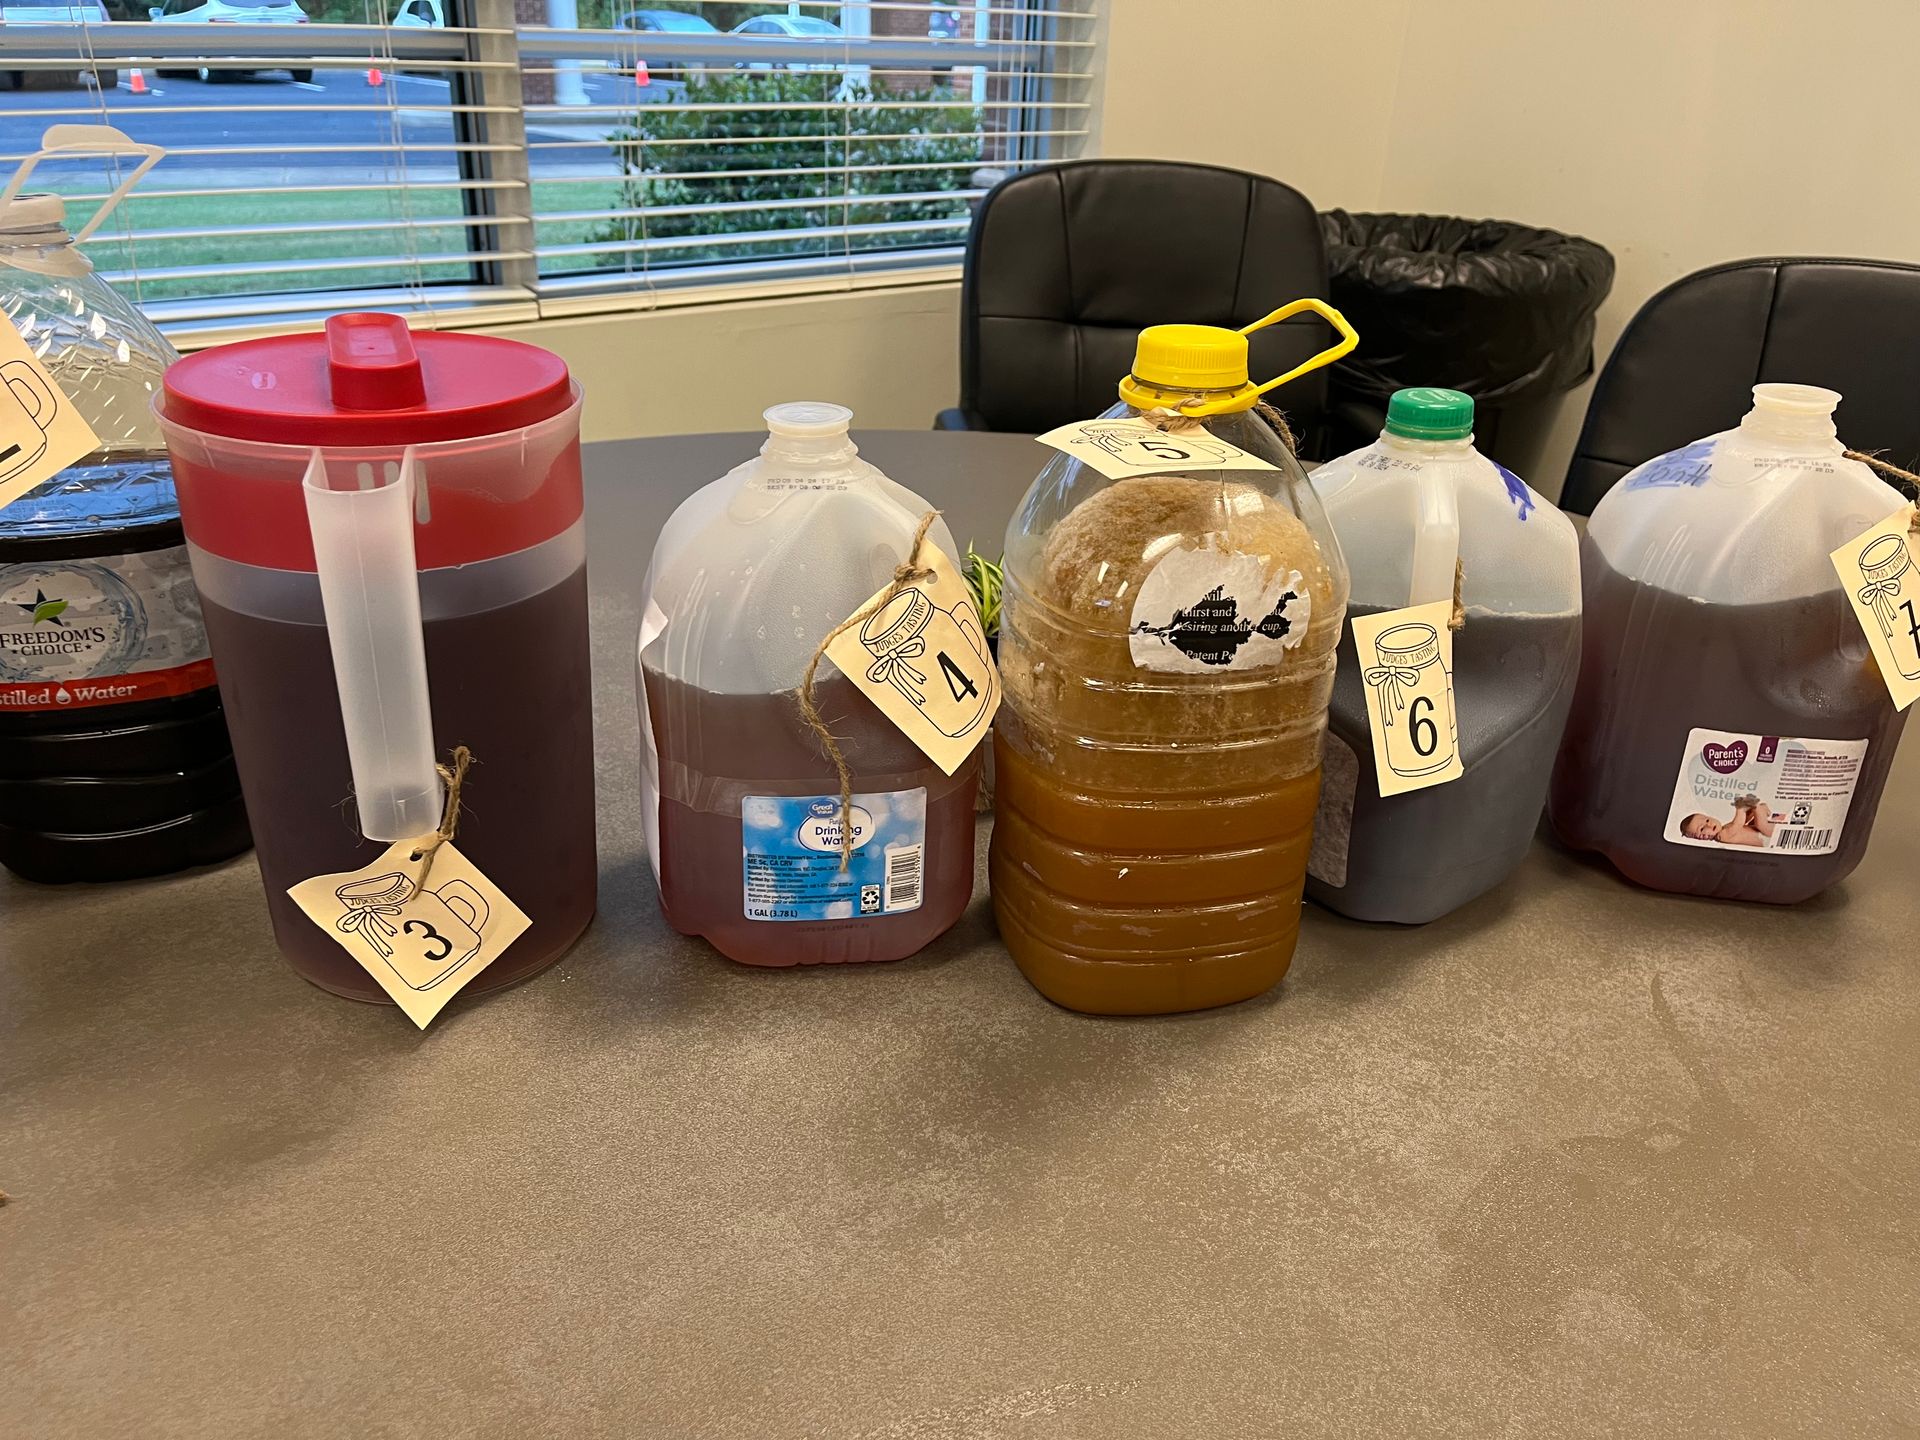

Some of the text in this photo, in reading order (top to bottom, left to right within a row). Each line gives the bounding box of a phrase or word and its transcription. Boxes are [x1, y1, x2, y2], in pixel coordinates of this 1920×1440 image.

[1138, 441, 1191, 460] 5
[1868, 568, 1889, 581] JUDGES
[1212, 606, 1233, 617] and
[875, 600, 927, 653] JUDGES TASTING
[1220, 620, 1258, 632] another
[1262, 622, 1282, 633] cup.
[0, 627, 105, 649] FREEDOM'S
[21, 643, 83, 656] CHOICE
[1185, 650, 1234, 661] Patent Pe
[1382, 644, 1436, 665] JUDGES TASTING
[936, 650, 979, 703] 4
[73, 684, 138, 701] Water
[1408, 696, 1438, 757] 6
[1708, 746, 1744, 760] Parent's
[1713, 758, 1739, 767] CHOICE
[1695, 773, 1759, 791] Distilled
[1693, 785, 1741, 801] Water
[811, 803, 834, 811] Great
[815, 825, 862, 836] Drinkng
[821, 836, 856, 845] Watr
[381, 884, 411, 903] TASTING
[748, 908, 798, 918] 1 GAL (3.78 L)
[403, 919, 453, 961] 3
